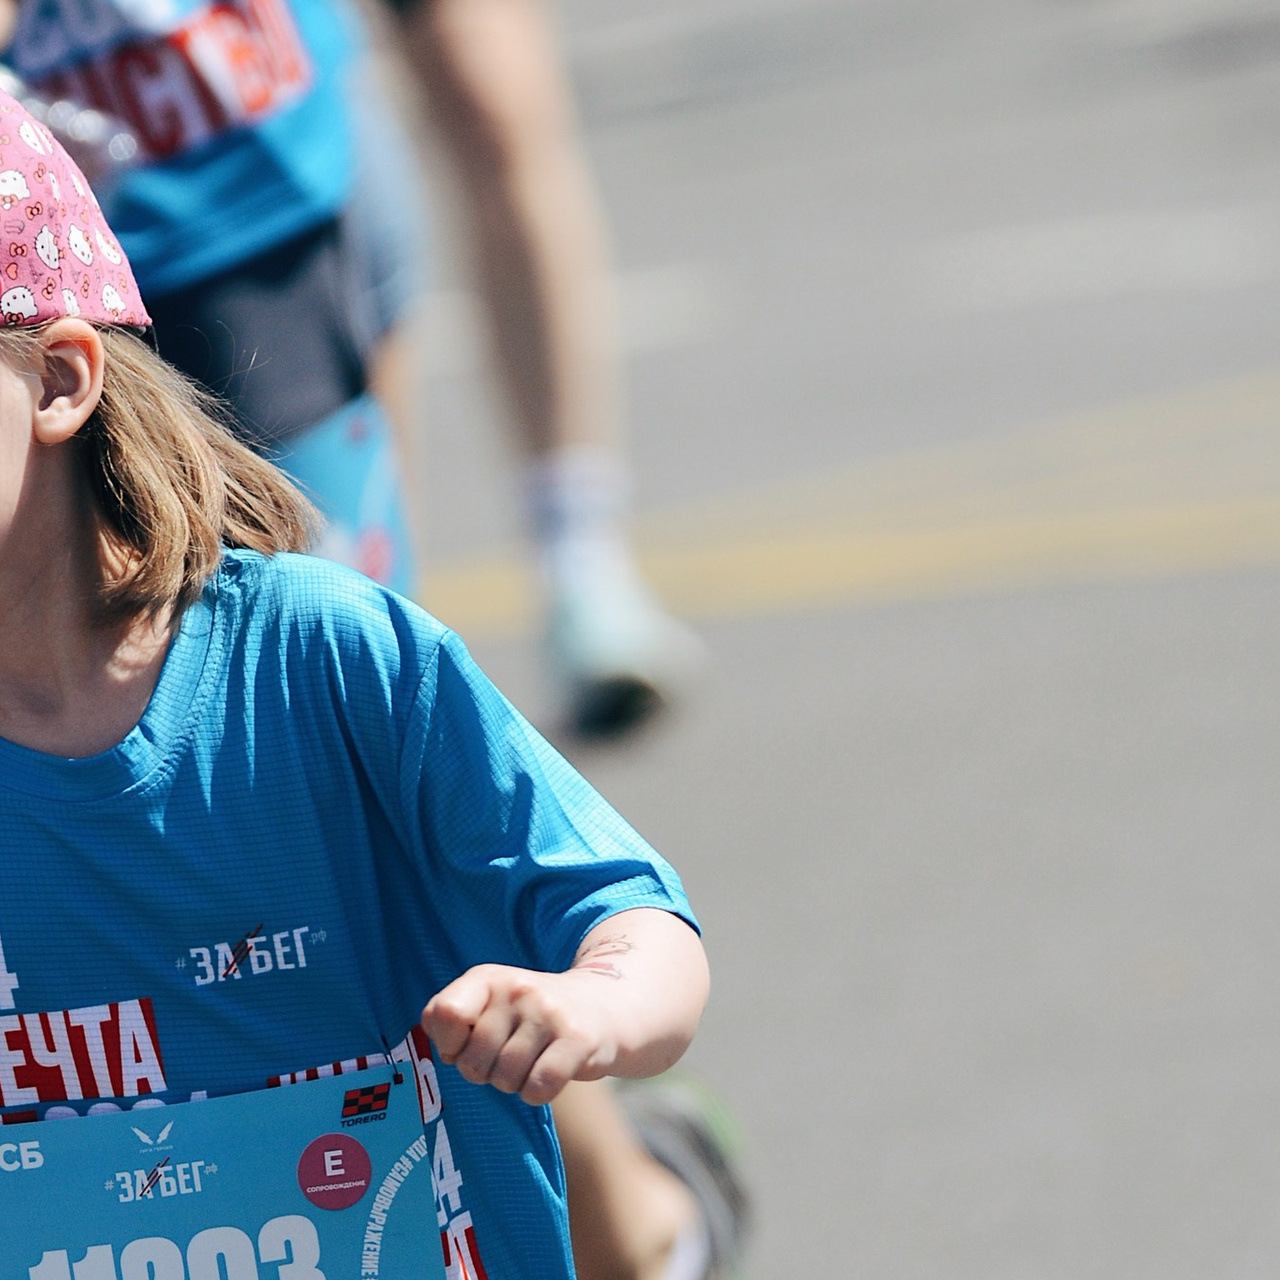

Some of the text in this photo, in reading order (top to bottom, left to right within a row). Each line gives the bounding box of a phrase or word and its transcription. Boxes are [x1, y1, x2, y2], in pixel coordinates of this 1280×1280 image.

[341, 1112, 387, 1128] TORERO
[306, 1179, 367, 1194] СОПРОВОЖДЕНИЕ
[360, 1154, 415, 1277] #САМОВЫРАЖЕНИЕ
